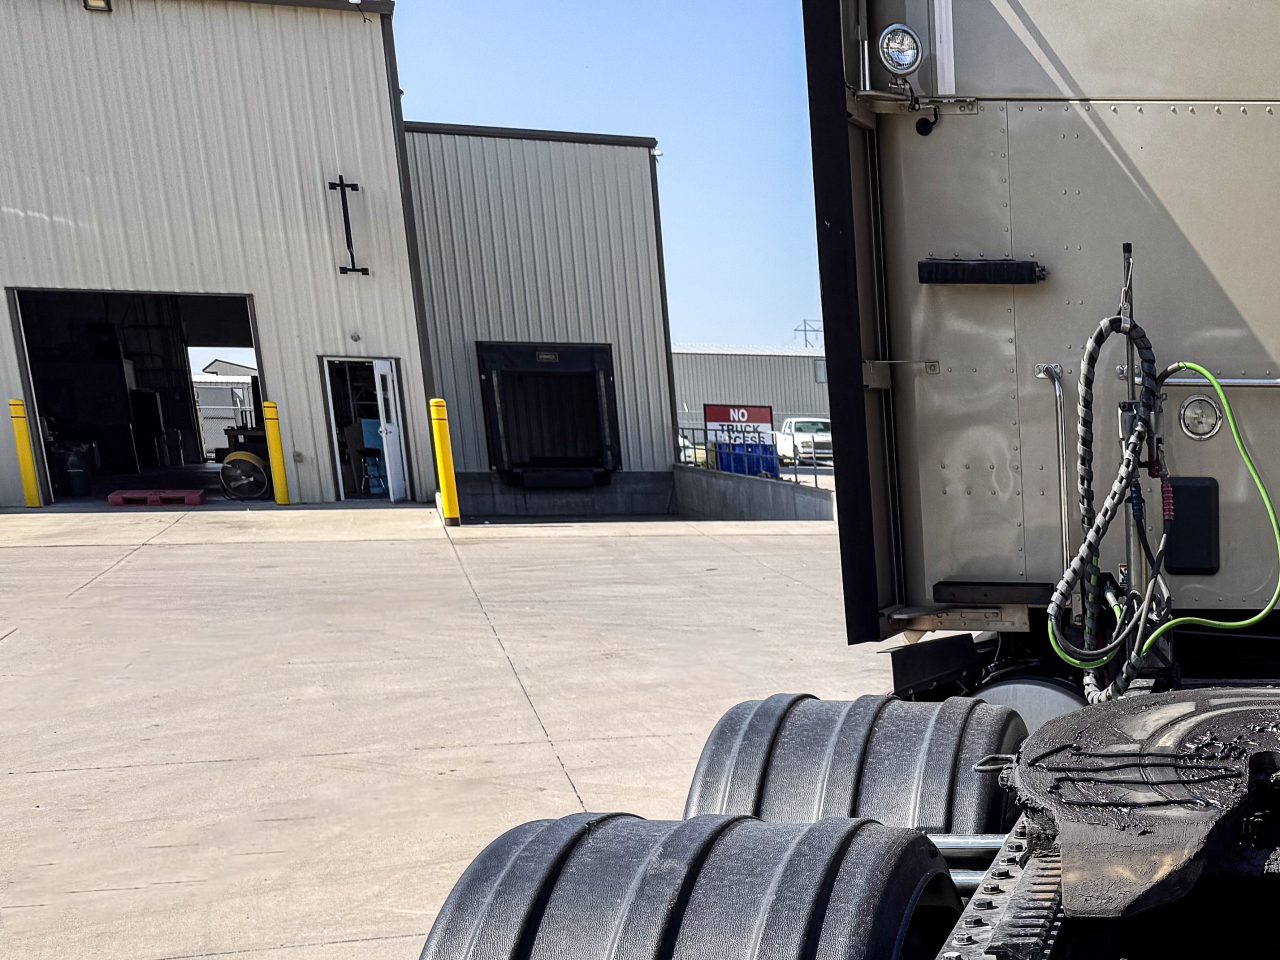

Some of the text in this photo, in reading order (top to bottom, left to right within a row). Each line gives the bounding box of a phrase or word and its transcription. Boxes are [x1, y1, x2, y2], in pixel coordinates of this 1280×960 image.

[729, 408, 748, 422] NO
[719, 423, 761, 434] TRUCK
[719, 435, 766, 444] CESS
